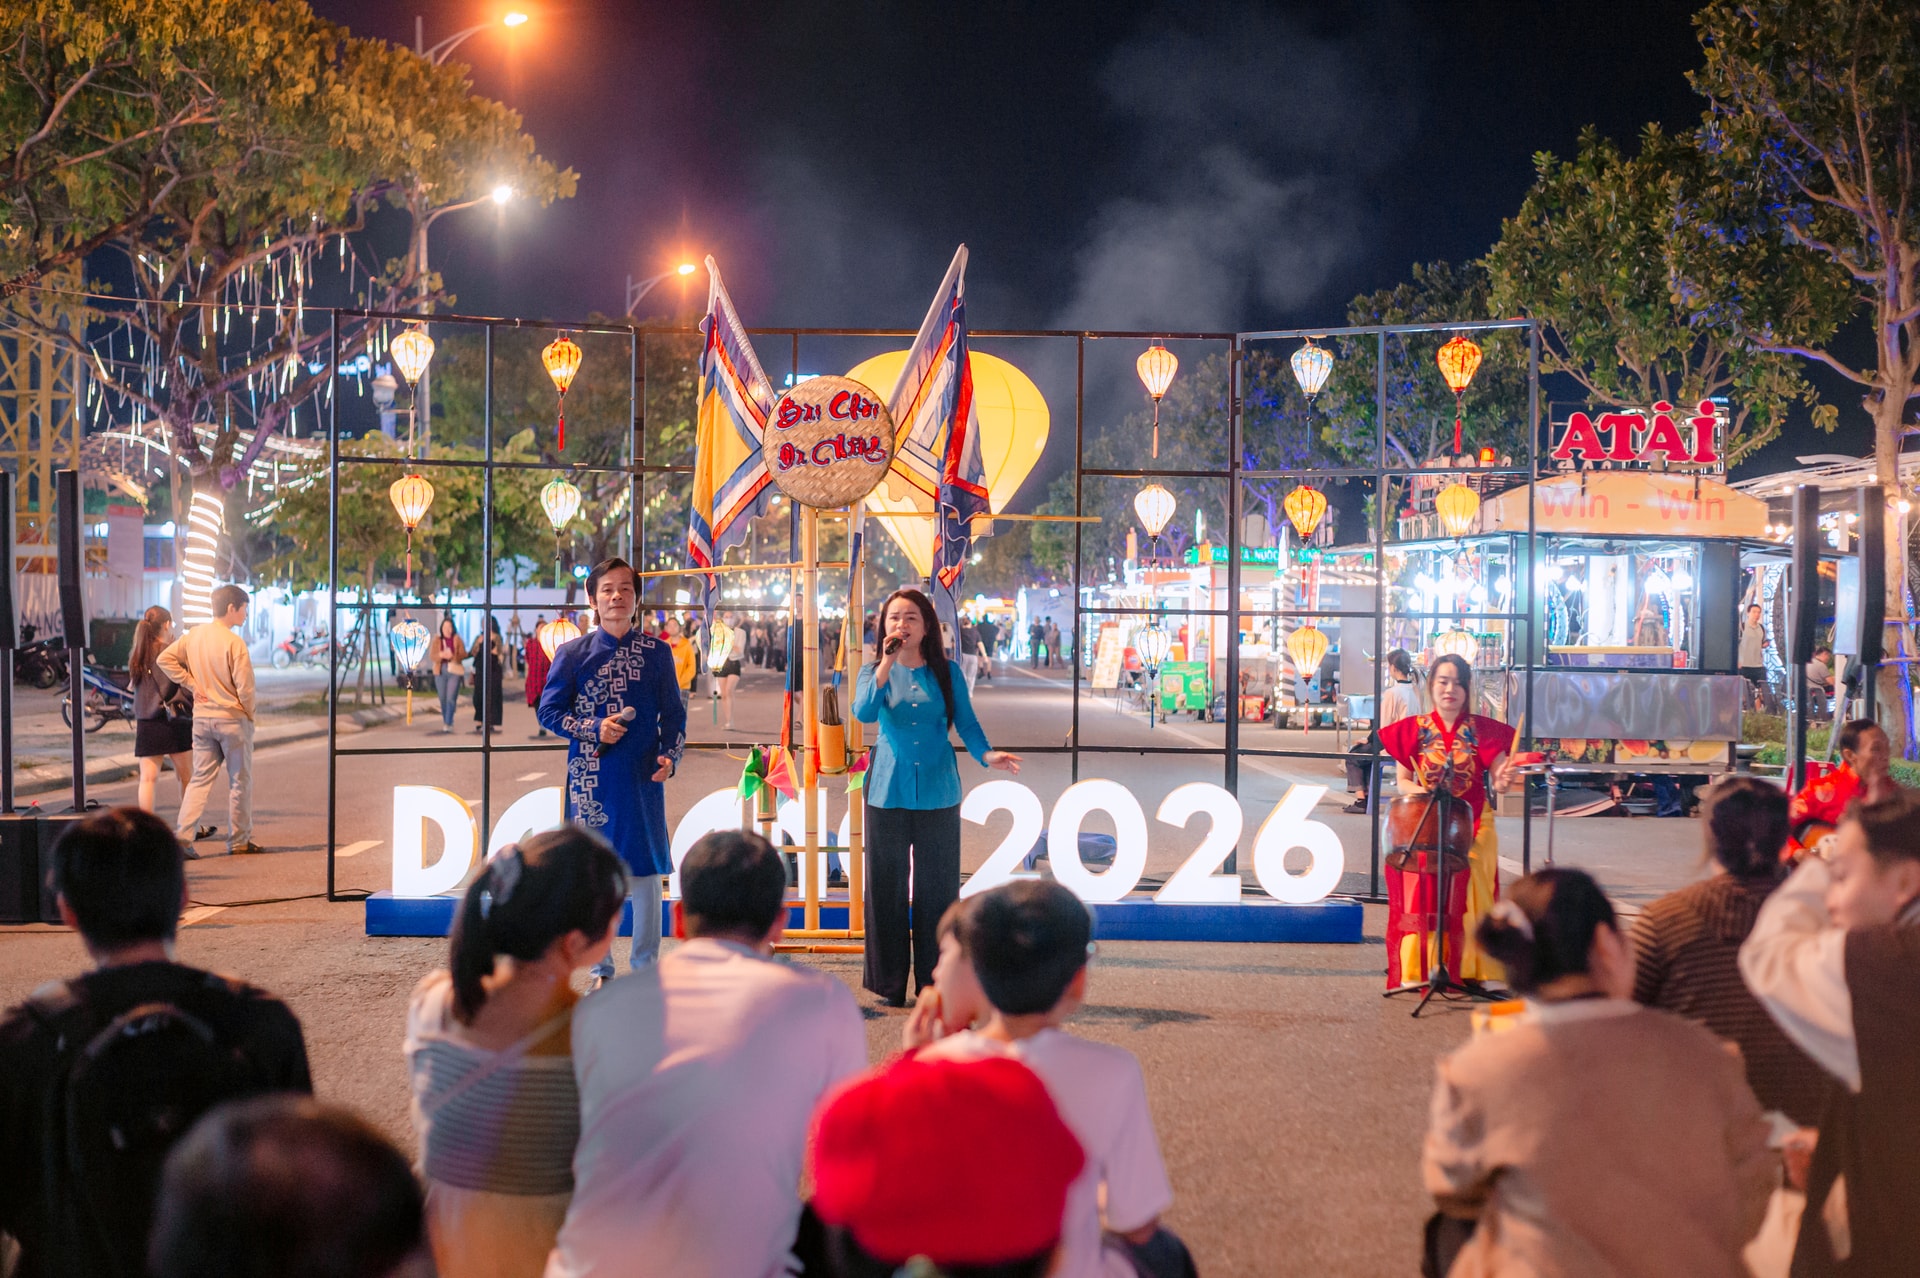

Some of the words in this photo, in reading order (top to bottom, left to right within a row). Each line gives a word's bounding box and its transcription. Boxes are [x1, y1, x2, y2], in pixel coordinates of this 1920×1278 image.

[1540, 487, 1609, 519] Win
[1656, 488, 1725, 521] Win
[960, 778, 1345, 903] 2026
